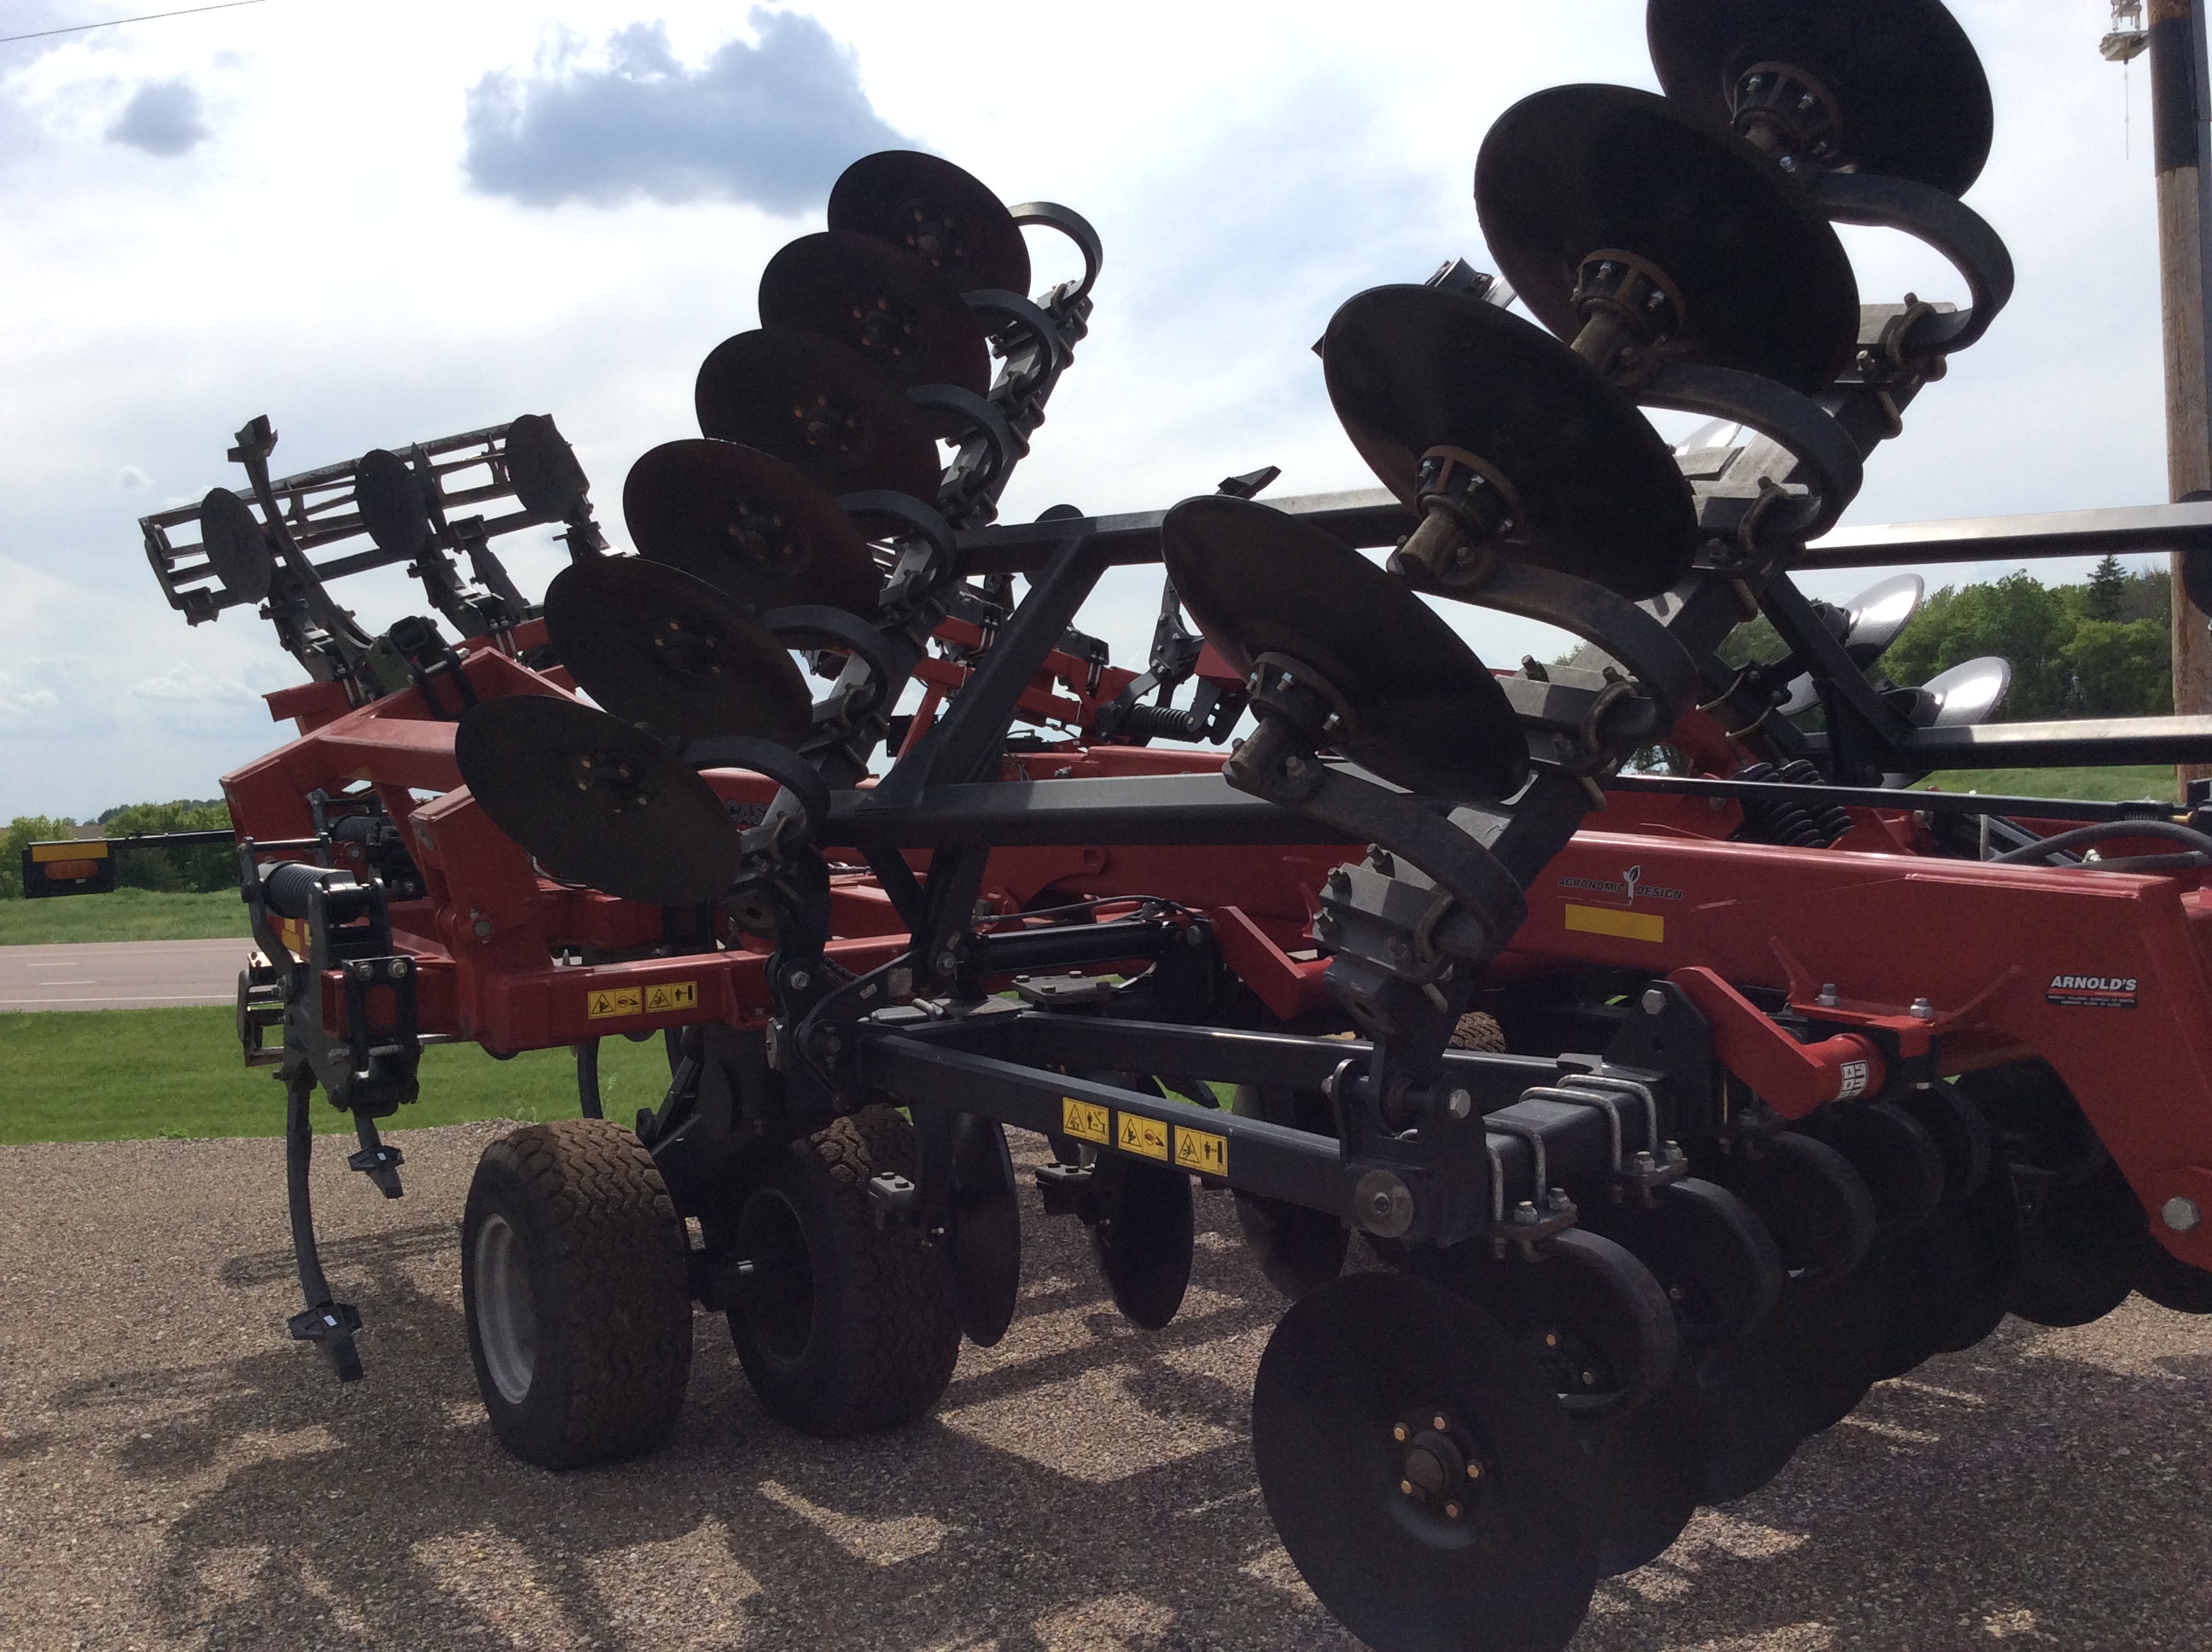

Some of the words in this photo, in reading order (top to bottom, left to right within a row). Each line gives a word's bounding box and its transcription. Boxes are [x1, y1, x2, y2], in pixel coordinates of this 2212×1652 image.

[725, 799, 771, 825] CAS
[1557, 876, 1626, 893] AGRONOMIC
[1636, 885, 1684, 899] DESIGN
[2051, 975, 2137, 991] ARNOLD'S
